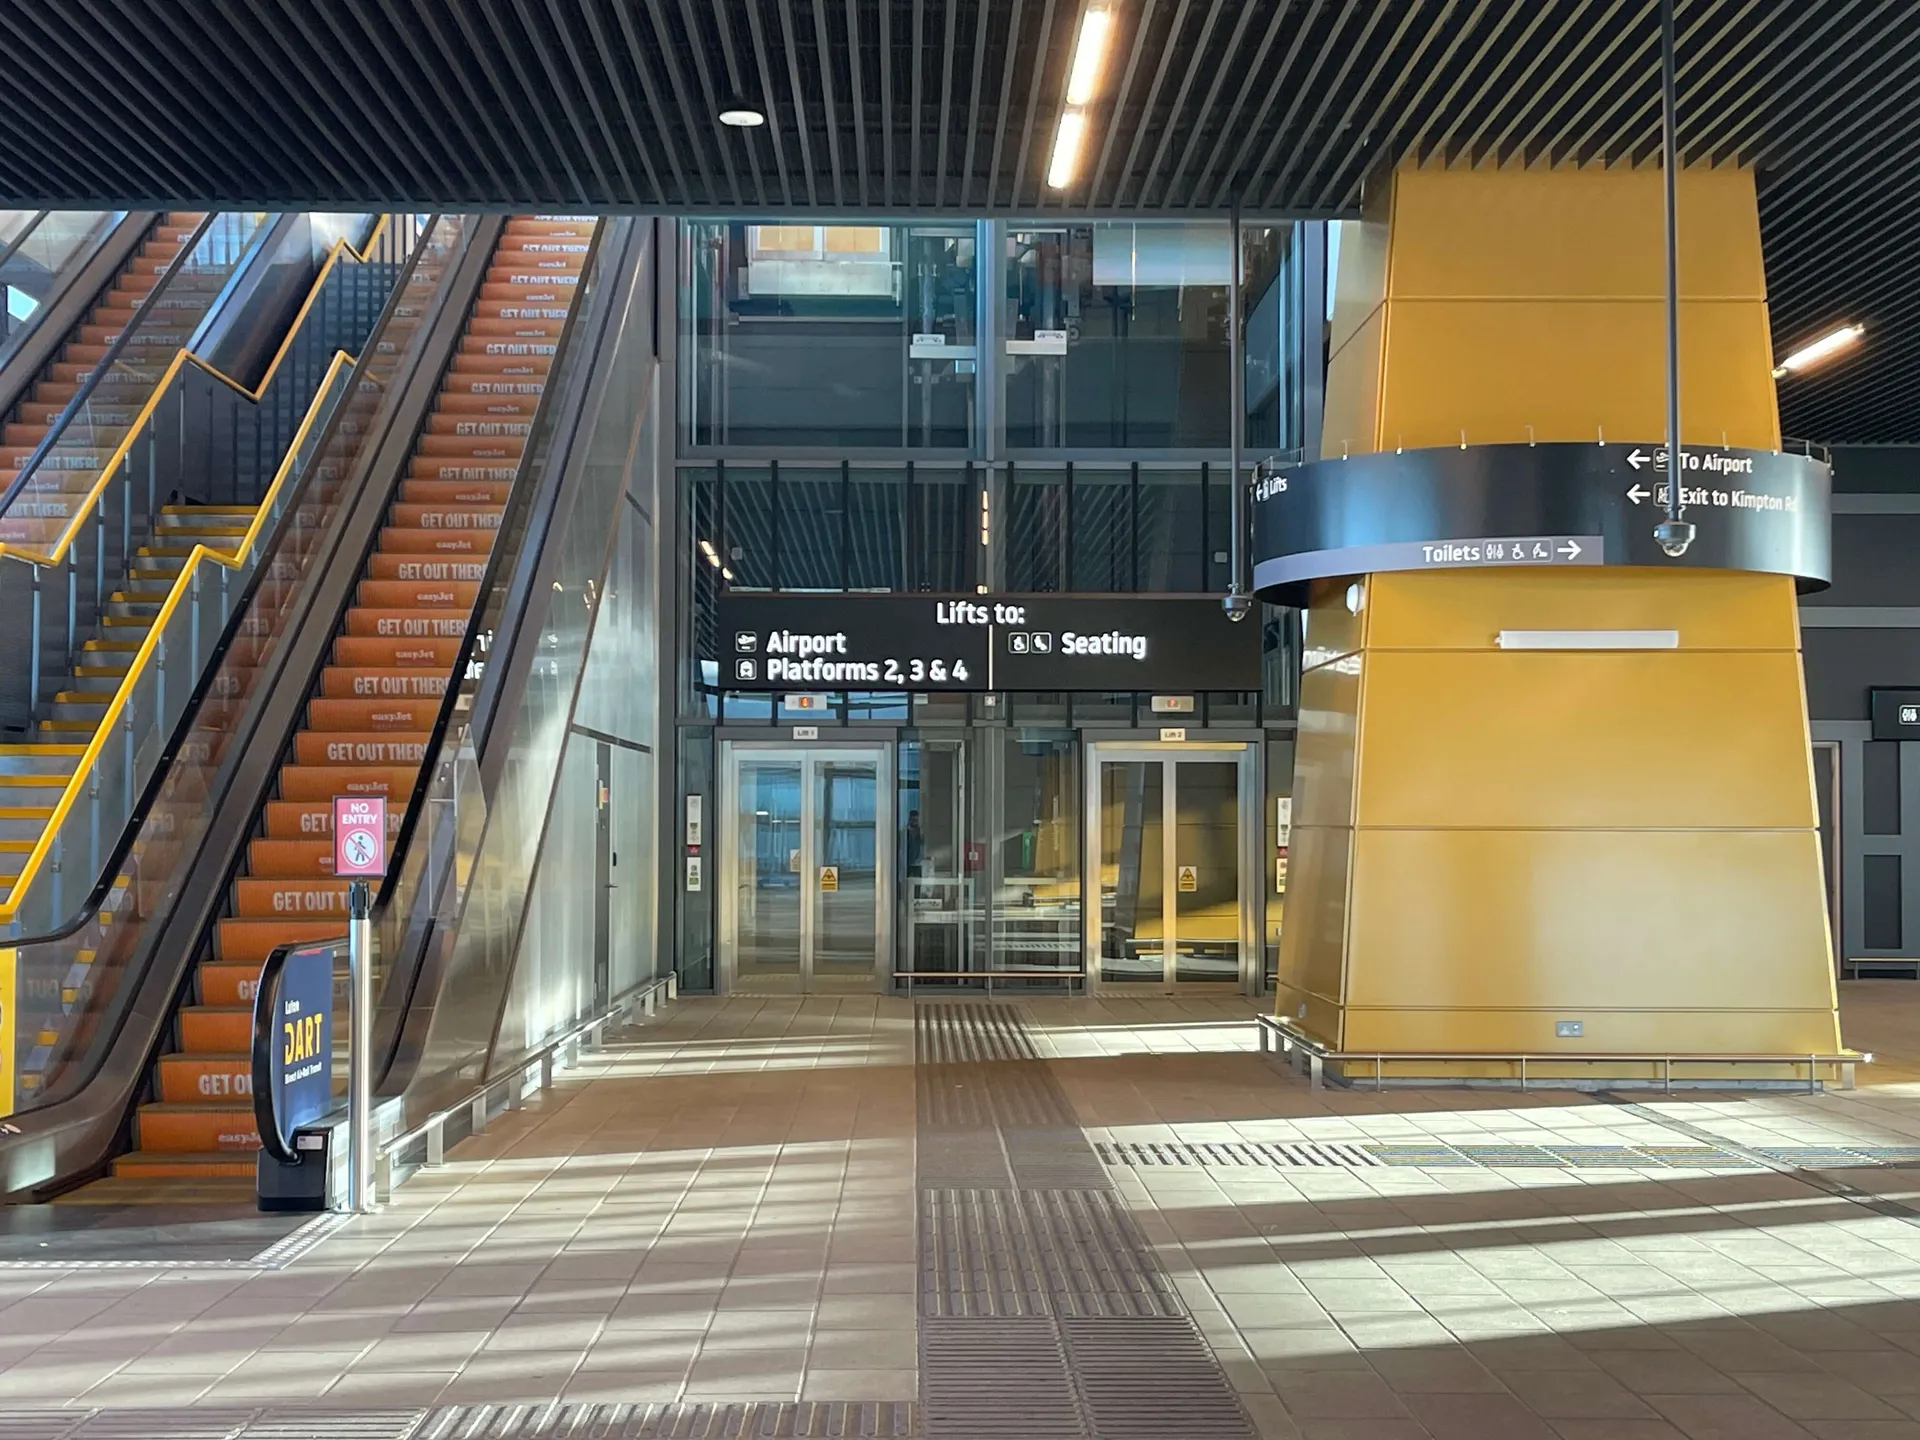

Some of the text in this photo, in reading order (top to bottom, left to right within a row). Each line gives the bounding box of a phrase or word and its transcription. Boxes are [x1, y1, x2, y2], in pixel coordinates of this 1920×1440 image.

[529, 345, 557, 355] THER
[516, 384, 545, 394] THER
[503, 423, 530, 435] THER
[487, 467, 517, 480] THER
[1679, 453, 1752, 475] To Airport
[1270, 476, 1288, 495] Lifts
[1679, 487, 1709, 505] Exit
[1712, 490, 1728, 506] to
[1731, 491, 1783, 512] Kimpton
[471, 513, 503, 528] THER
[1422, 545, 1480, 563] Toilets
[399, 563, 421, 579] GET
[423, 563, 450, 580] OUT
[937, 602, 1025, 624] Lifts to:
[377, 619, 401, 636] GET
[403, 619, 430, 636] OUT
[766, 630, 847, 658] Airport
[1061, 631, 1147, 660] Seating
[767, 657, 969, 684] Platforms 2, 3 & 4
[354, 676, 380, 695] GET
[381, 676, 408, 695] OUT
[327, 743, 354, 761] GET
[356, 743, 386, 761] OUT
[350, 803, 369, 814] NO
[301, 813, 328, 833] GET
[342, 814, 377, 825] ENTRY
[273, 892, 302, 911] GET
[304, 892, 335, 911] OUT
[237, 980, 257, 1000] GE
[285, 1013, 322, 1065] DART
[199, 1073, 231, 1095] GET
[218, 1132, 262, 1144] easyJe
